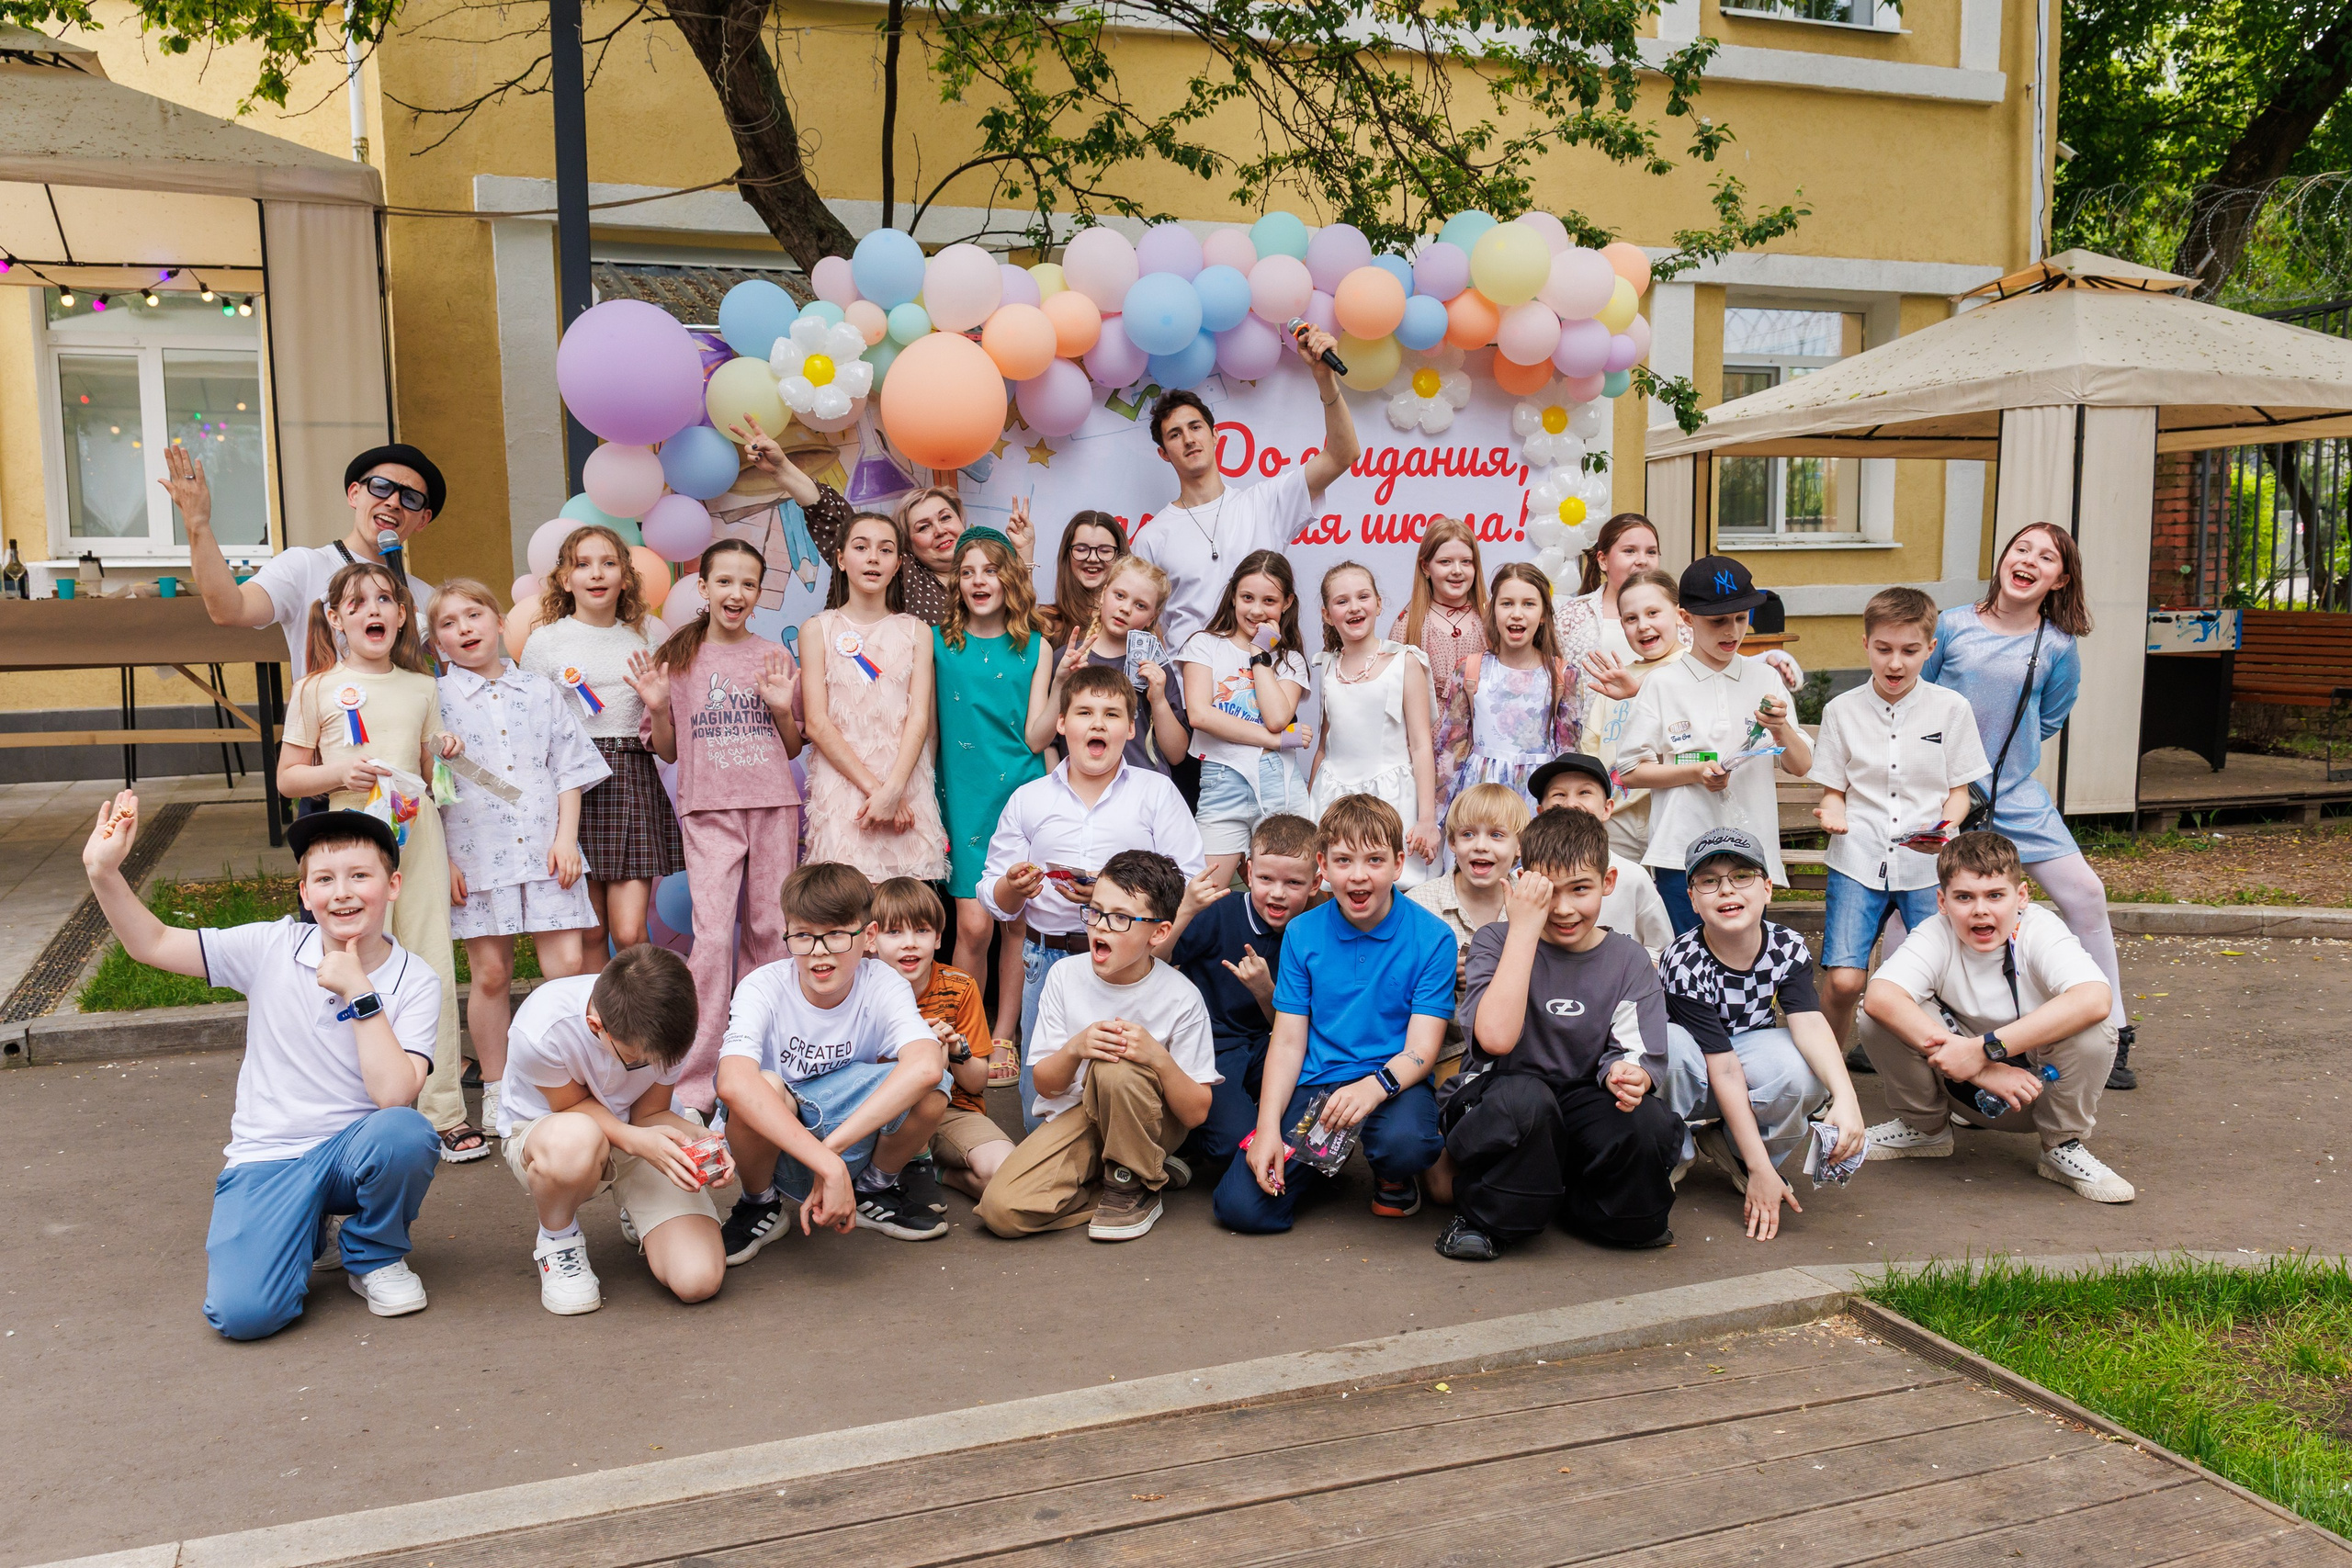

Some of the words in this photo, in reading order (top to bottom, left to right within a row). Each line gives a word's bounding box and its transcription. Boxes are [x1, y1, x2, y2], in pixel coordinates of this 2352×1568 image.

[1214, 421, 1291, 479] До
[1300, 434, 1530, 506] идания,
[1693, 835, 1751, 854] Original
[789, 1036, 852, 1060] CREATED
[780, 1050, 797, 1068] BY
[797, 1057, 851, 1075] NATUR
